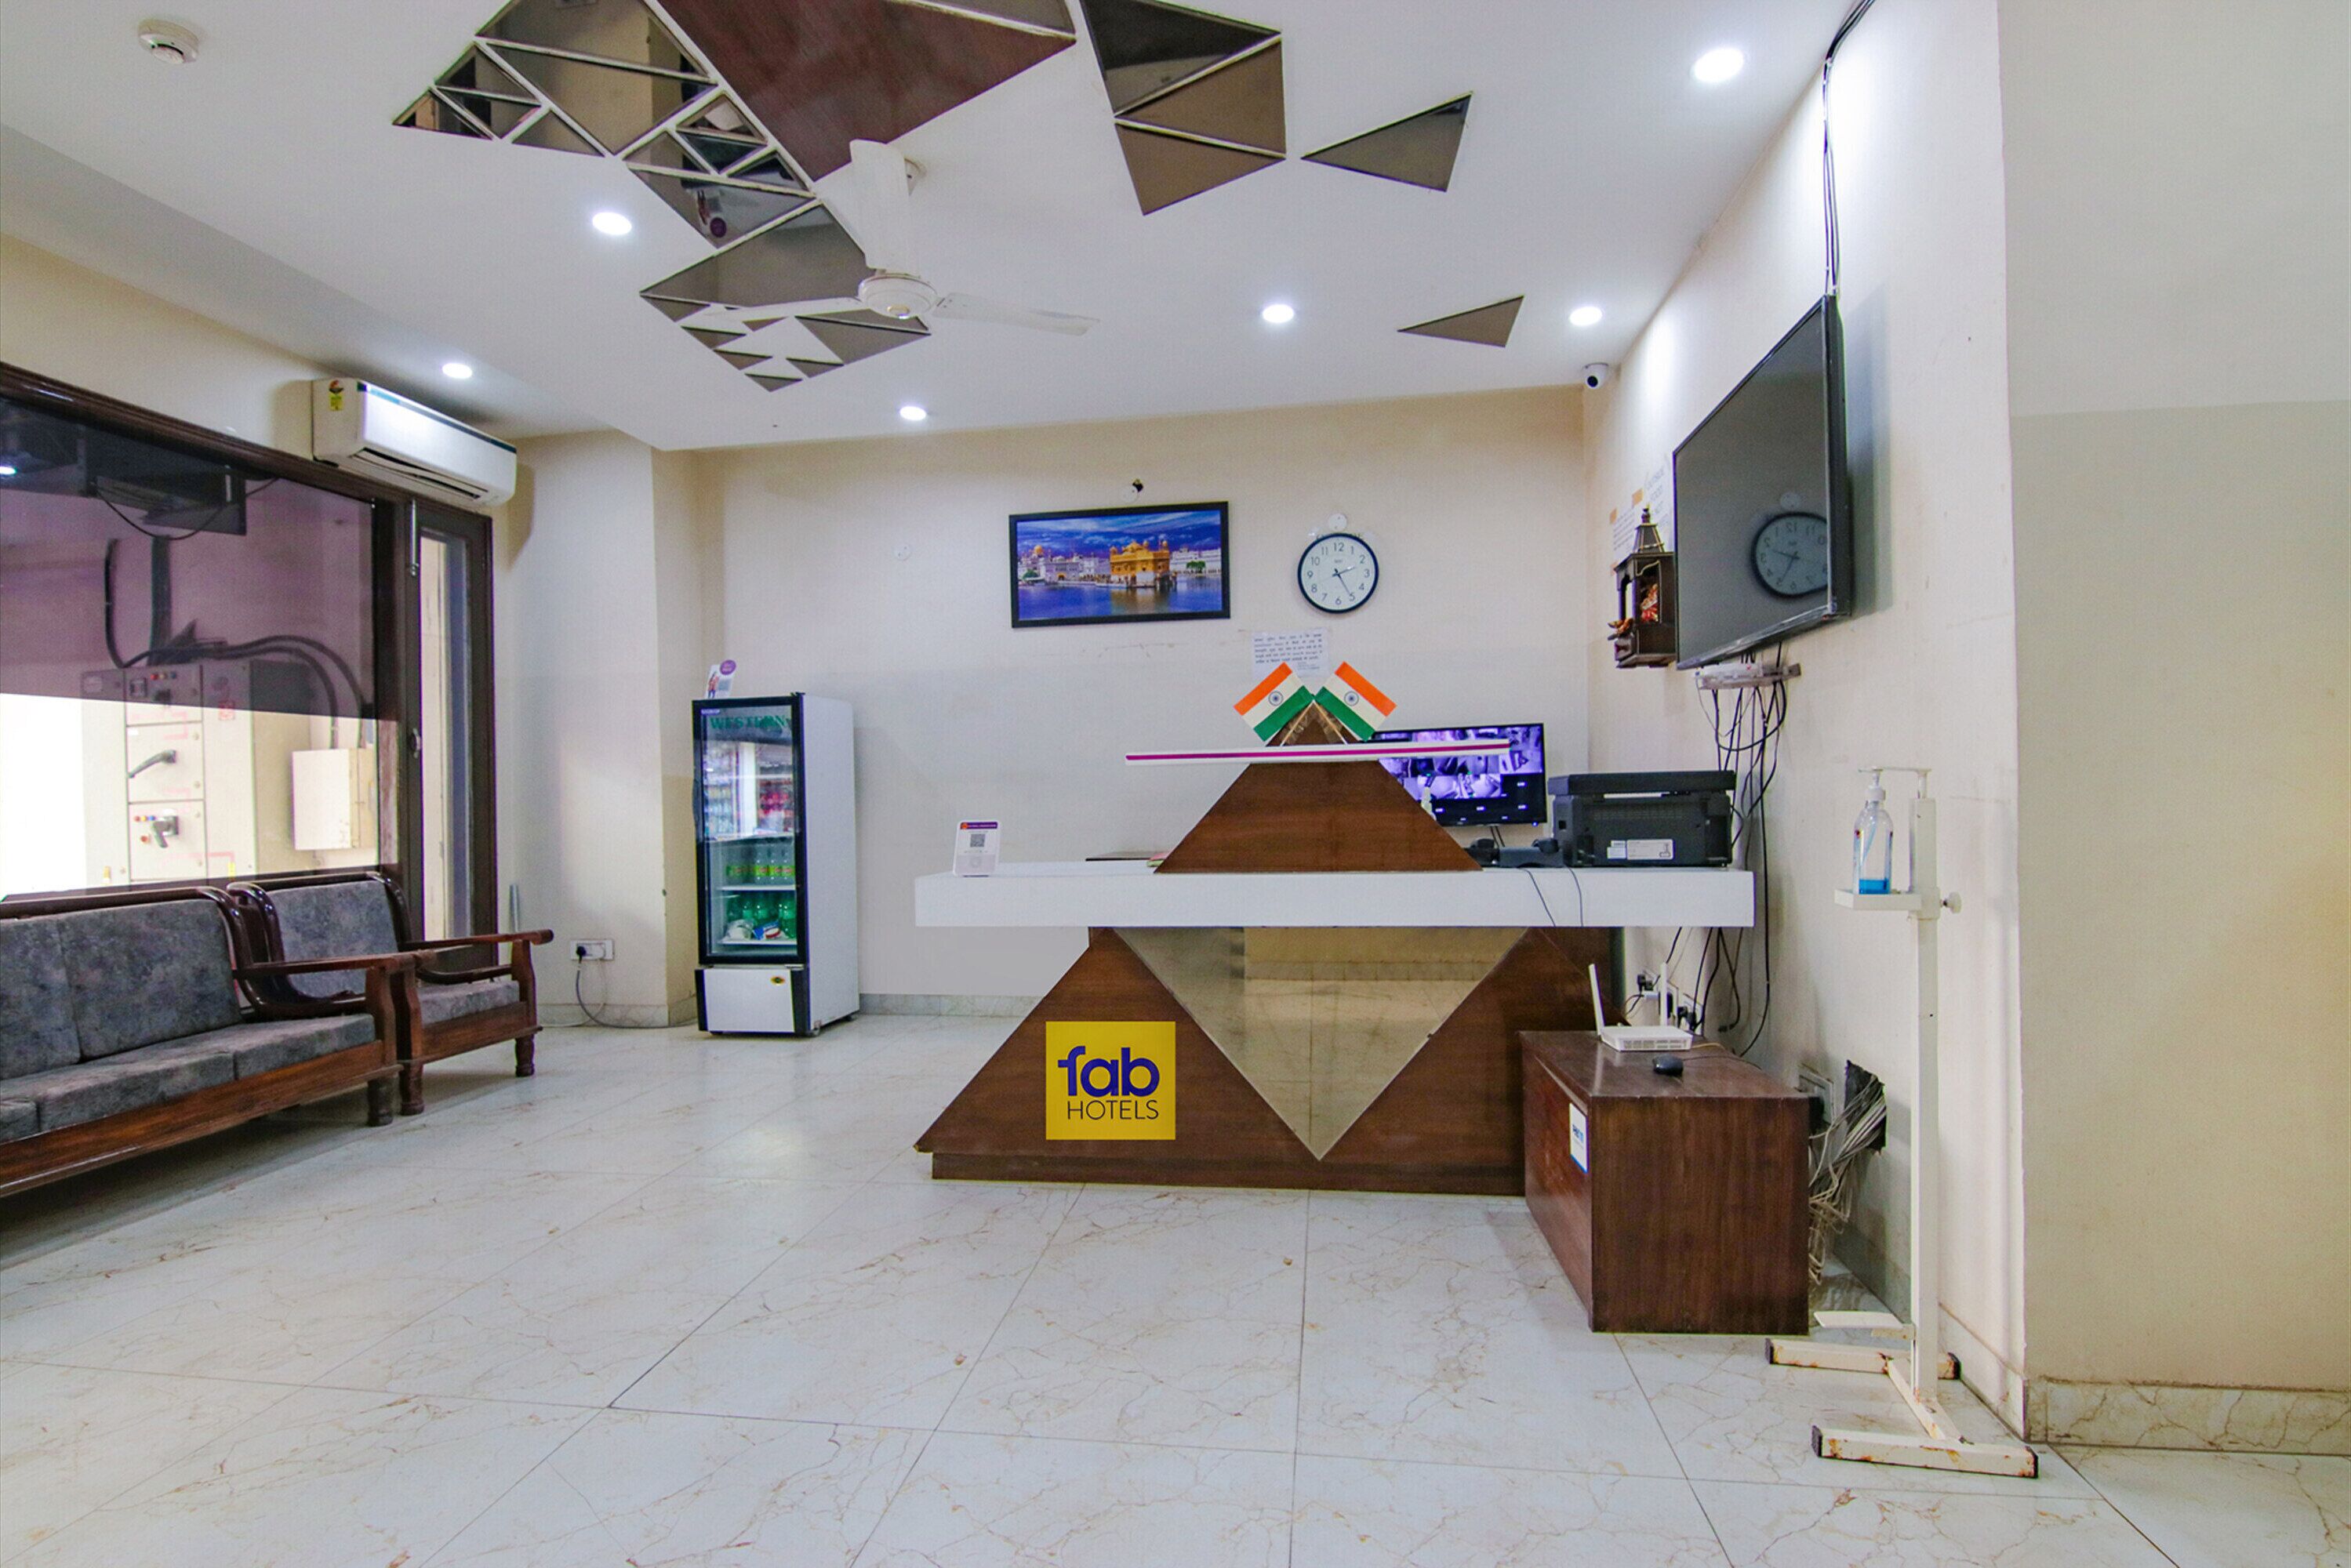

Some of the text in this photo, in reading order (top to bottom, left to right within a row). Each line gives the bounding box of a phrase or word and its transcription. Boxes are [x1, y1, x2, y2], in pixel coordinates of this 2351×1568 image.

[1321, 546, 1328, 555] 11
[1333, 542, 1344, 552] 12
[1310, 557, 1320, 565] 10
[1360, 554, 1366, 564] 2
[1307, 570, 1314, 579] 9
[1364, 568, 1370, 578] 3
[1311, 583, 1317, 593] 8
[1321, 593, 1328, 601] 7
[1349, 593, 1355, 601] 5
[1057, 1045, 1160, 1098] fab
[1067, 1099, 1159, 1120] HOTELS
